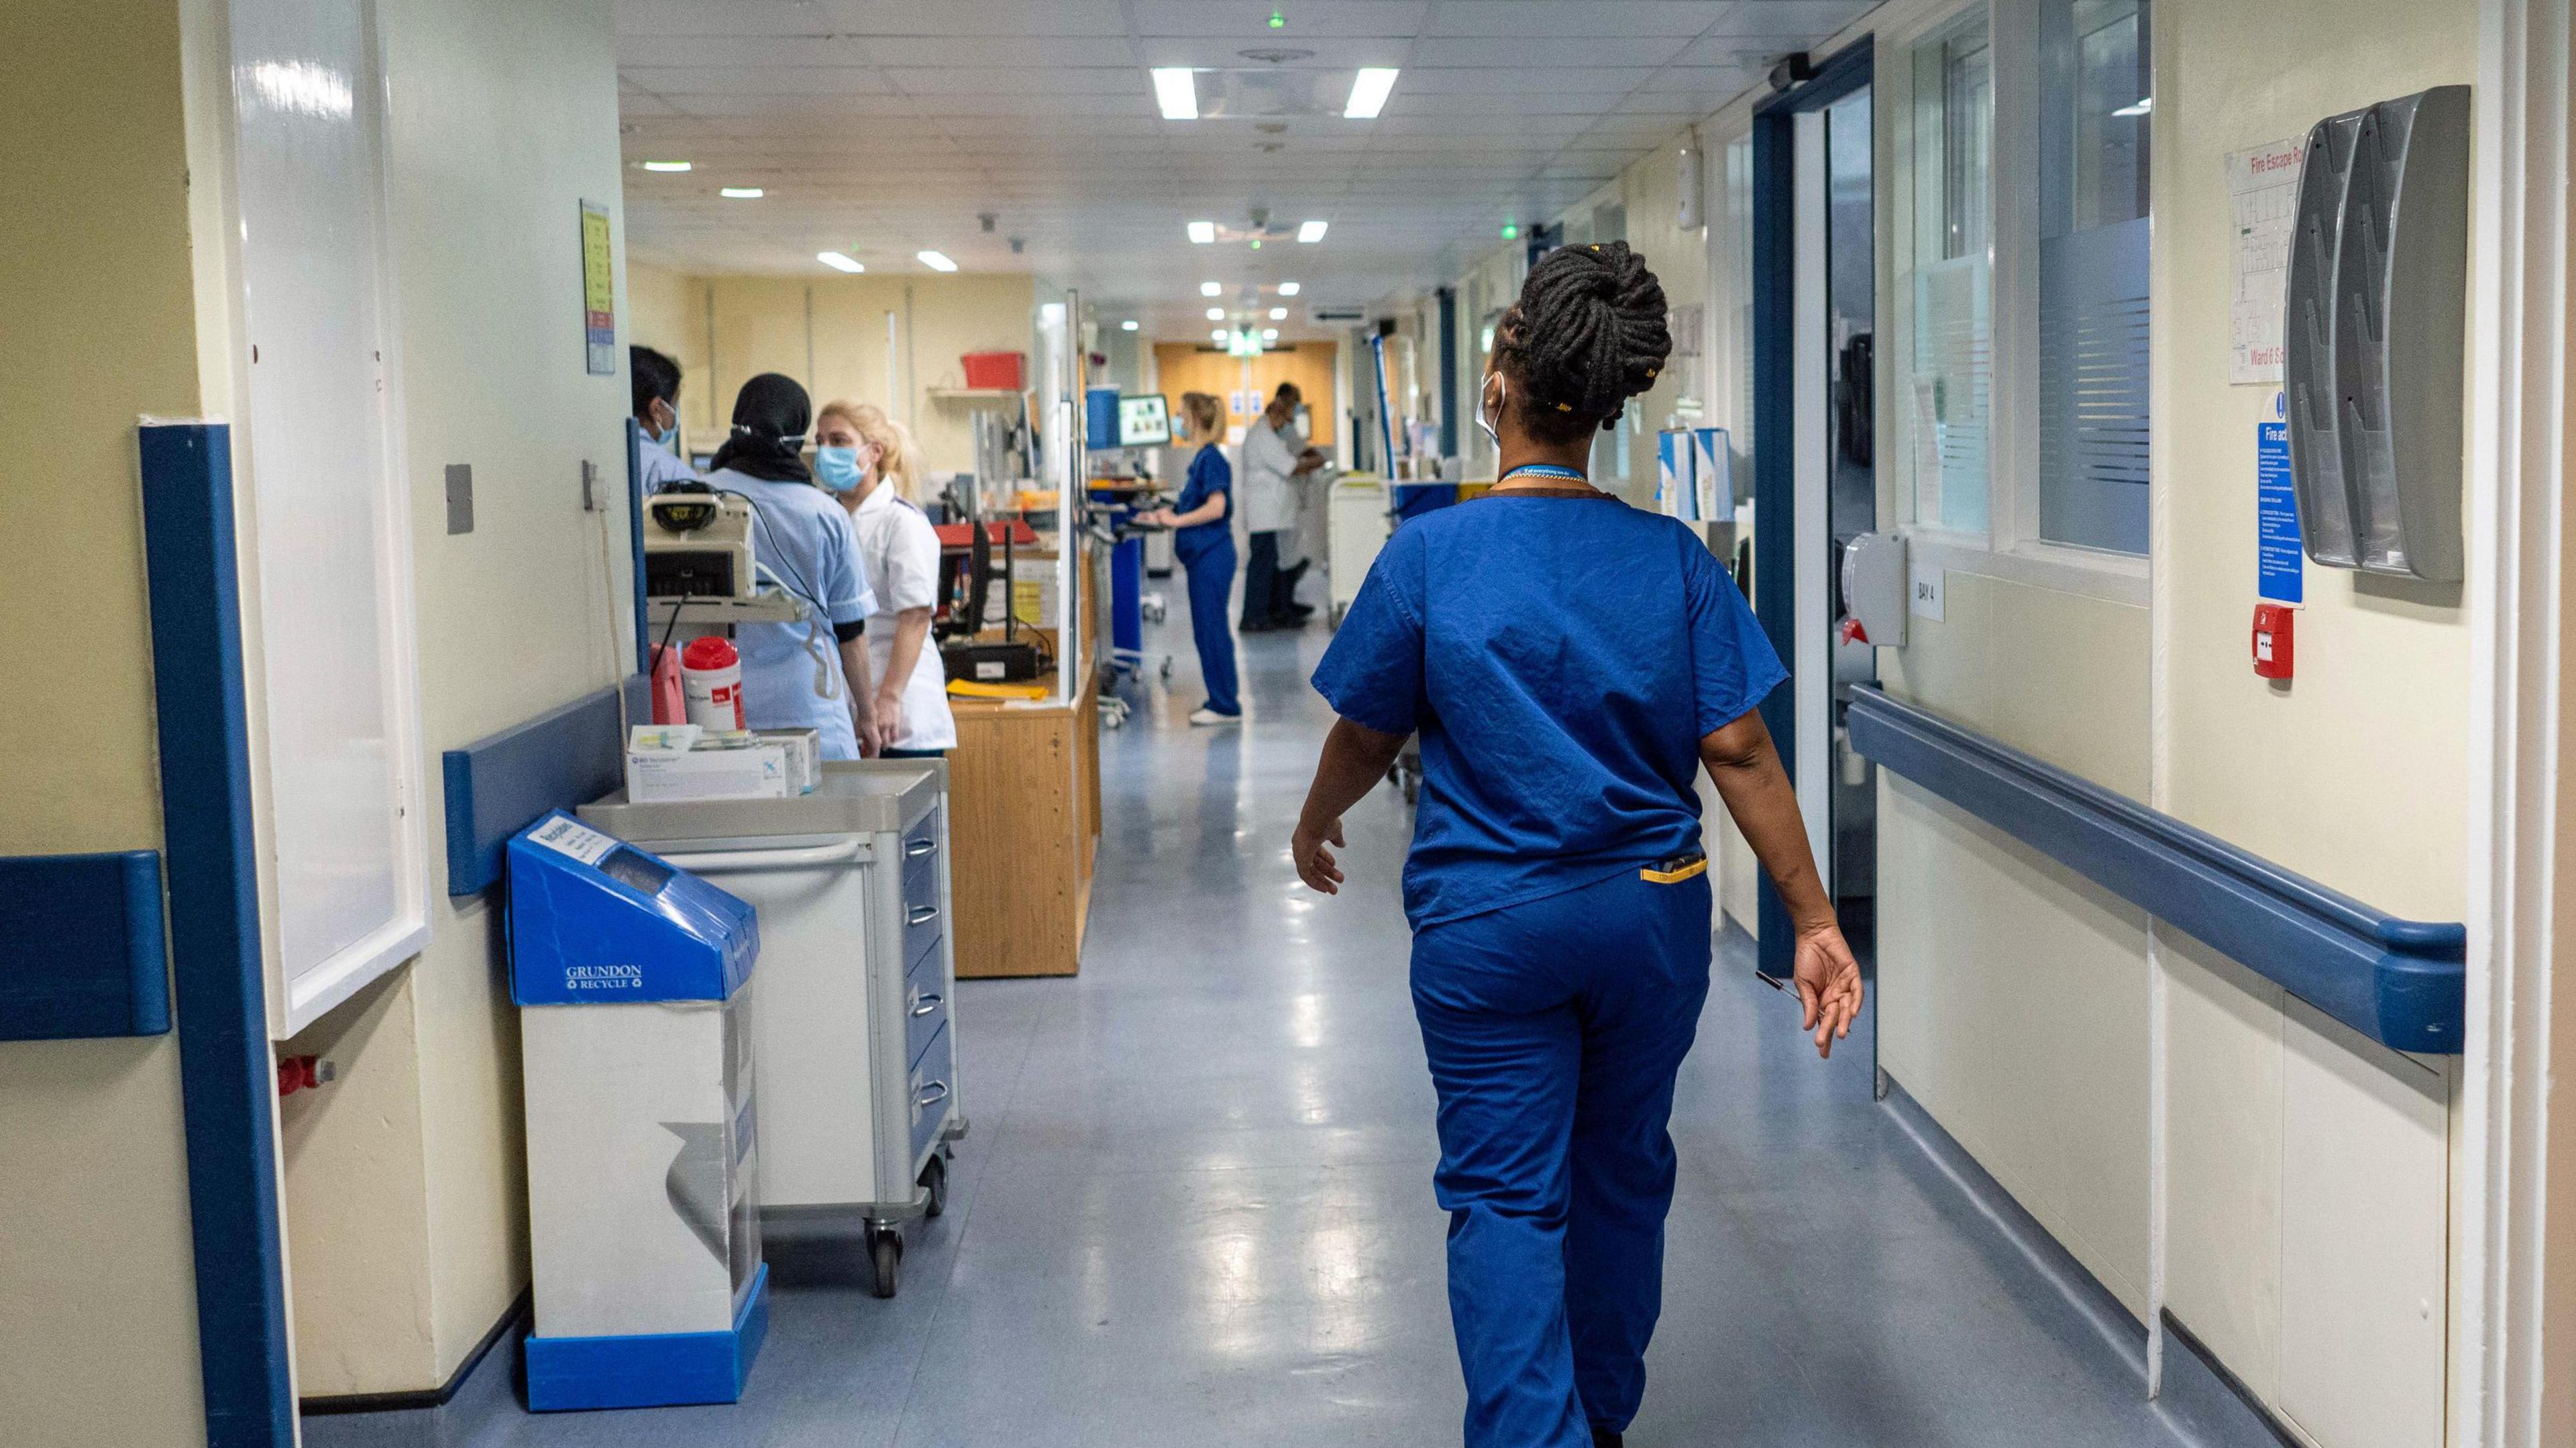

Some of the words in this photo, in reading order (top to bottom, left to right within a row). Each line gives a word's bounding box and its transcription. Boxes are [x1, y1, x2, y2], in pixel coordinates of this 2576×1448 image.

[2251, 156, 2265, 174] Fire
[2267, 153, 2292, 170] Escape
[2251, 348, 2268, 365] Ward
[2269, 347, 2273, 364] 6
[2265, 427, 2277, 441] Fire
[1919, 582, 1929, 601] BAY
[1929, 584, 1935, 602] 4
[566, 965, 642, 977] GRUNDON
[580, 979, 628, 989] RECYCLE
